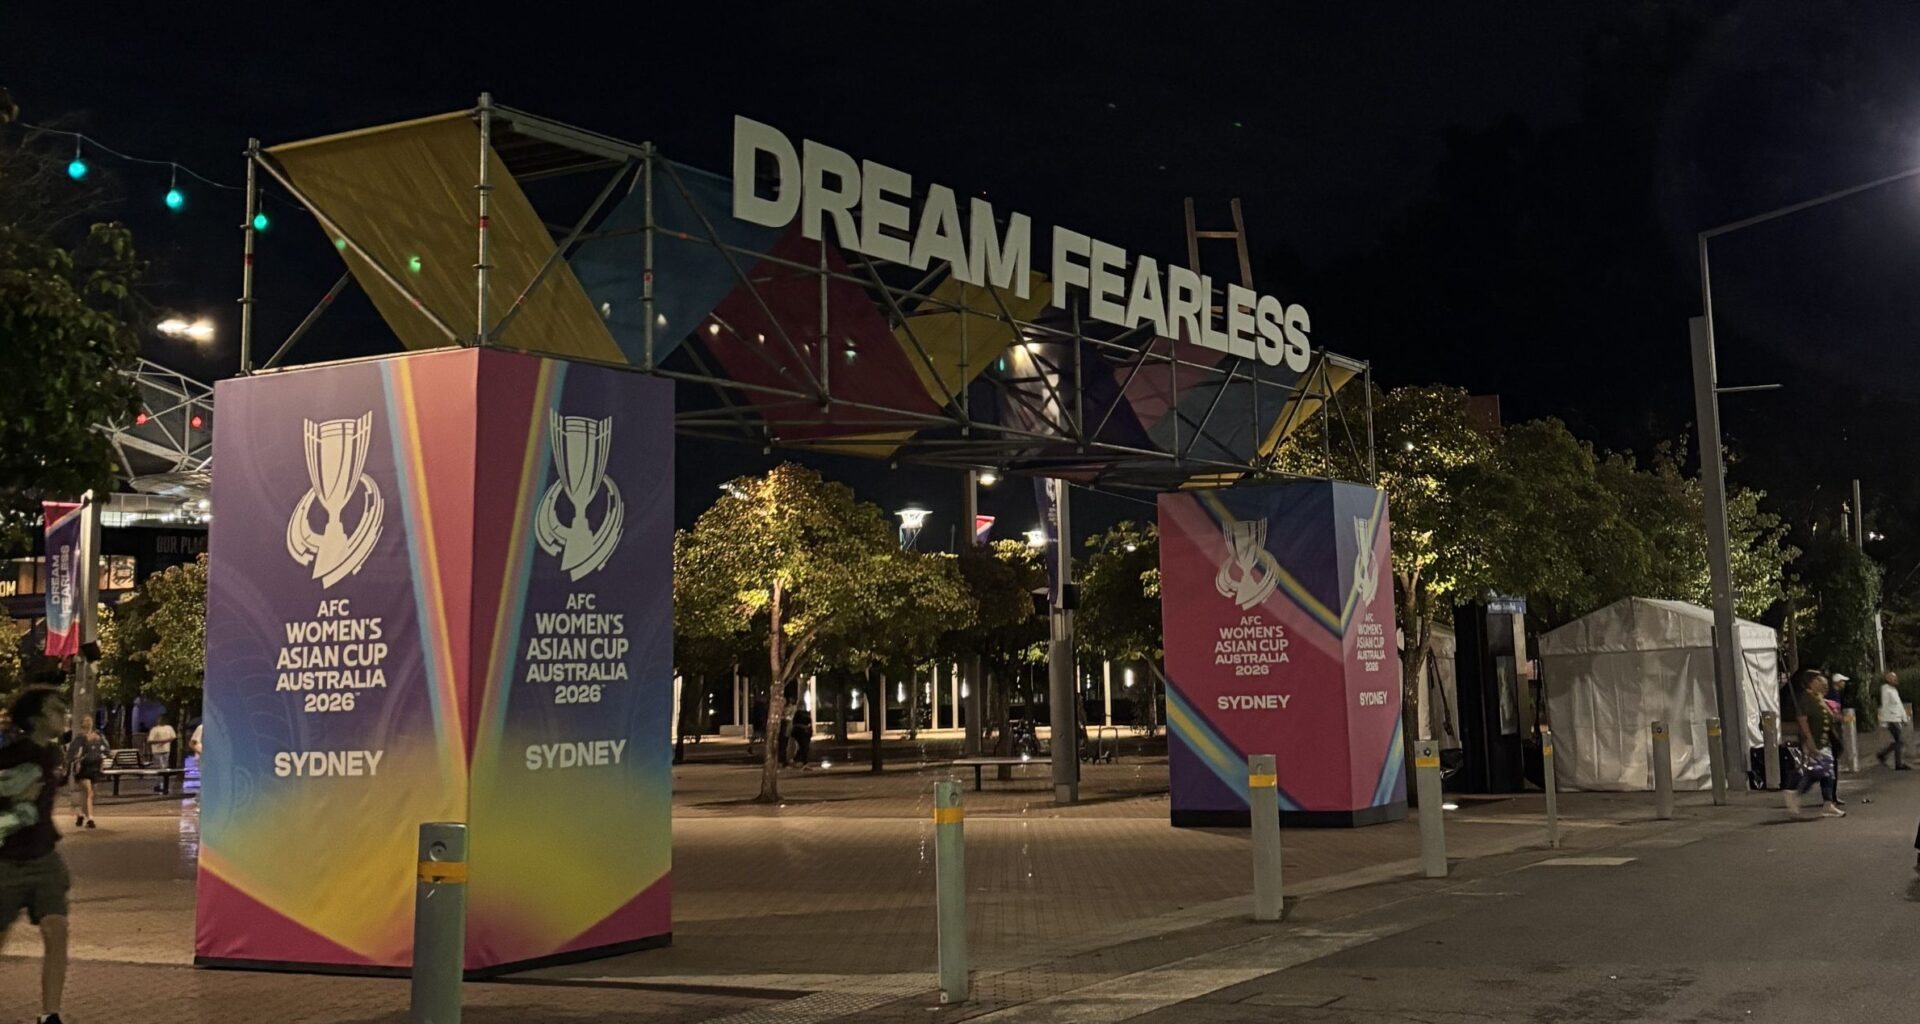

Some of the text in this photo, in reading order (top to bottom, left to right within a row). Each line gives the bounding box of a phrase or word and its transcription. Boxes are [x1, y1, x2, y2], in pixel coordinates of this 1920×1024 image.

[733, 114, 1311, 373] DREAM FEARLESS
[51, 554, 60, 604] DREAM
[317, 599, 350, 617] AFC
[566, 593, 596, 610] AFC
[286, 618, 382, 644] WOMEN'S
[535, 613, 624, 635] WOMEN'S
[1240, 616, 1262, 626] AFC
[1219, 626, 1284, 639] WOMEN'S
[1374, 636, 1385, 648] CUP
[276, 643, 388, 669] ASIAN CUP
[526, 637, 629, 660] ASIAN CUP
[1215, 640, 1289, 653] ASIAN CUP
[1215, 653, 1289, 664] AUSTRALIA
[276, 669, 386, 691] AUSTRALIA
[526, 662, 628, 683] AUSTRALIA
[1235, 665, 1269, 676] 2026
[554, 684, 601, 704] 2026
[1217, 695, 1290, 710] SYDNEY
[1359, 691, 1388, 706] SYDNEY
[274, 750, 384, 777] SYDNEY
[526, 739, 626, 770] SYDNEY
